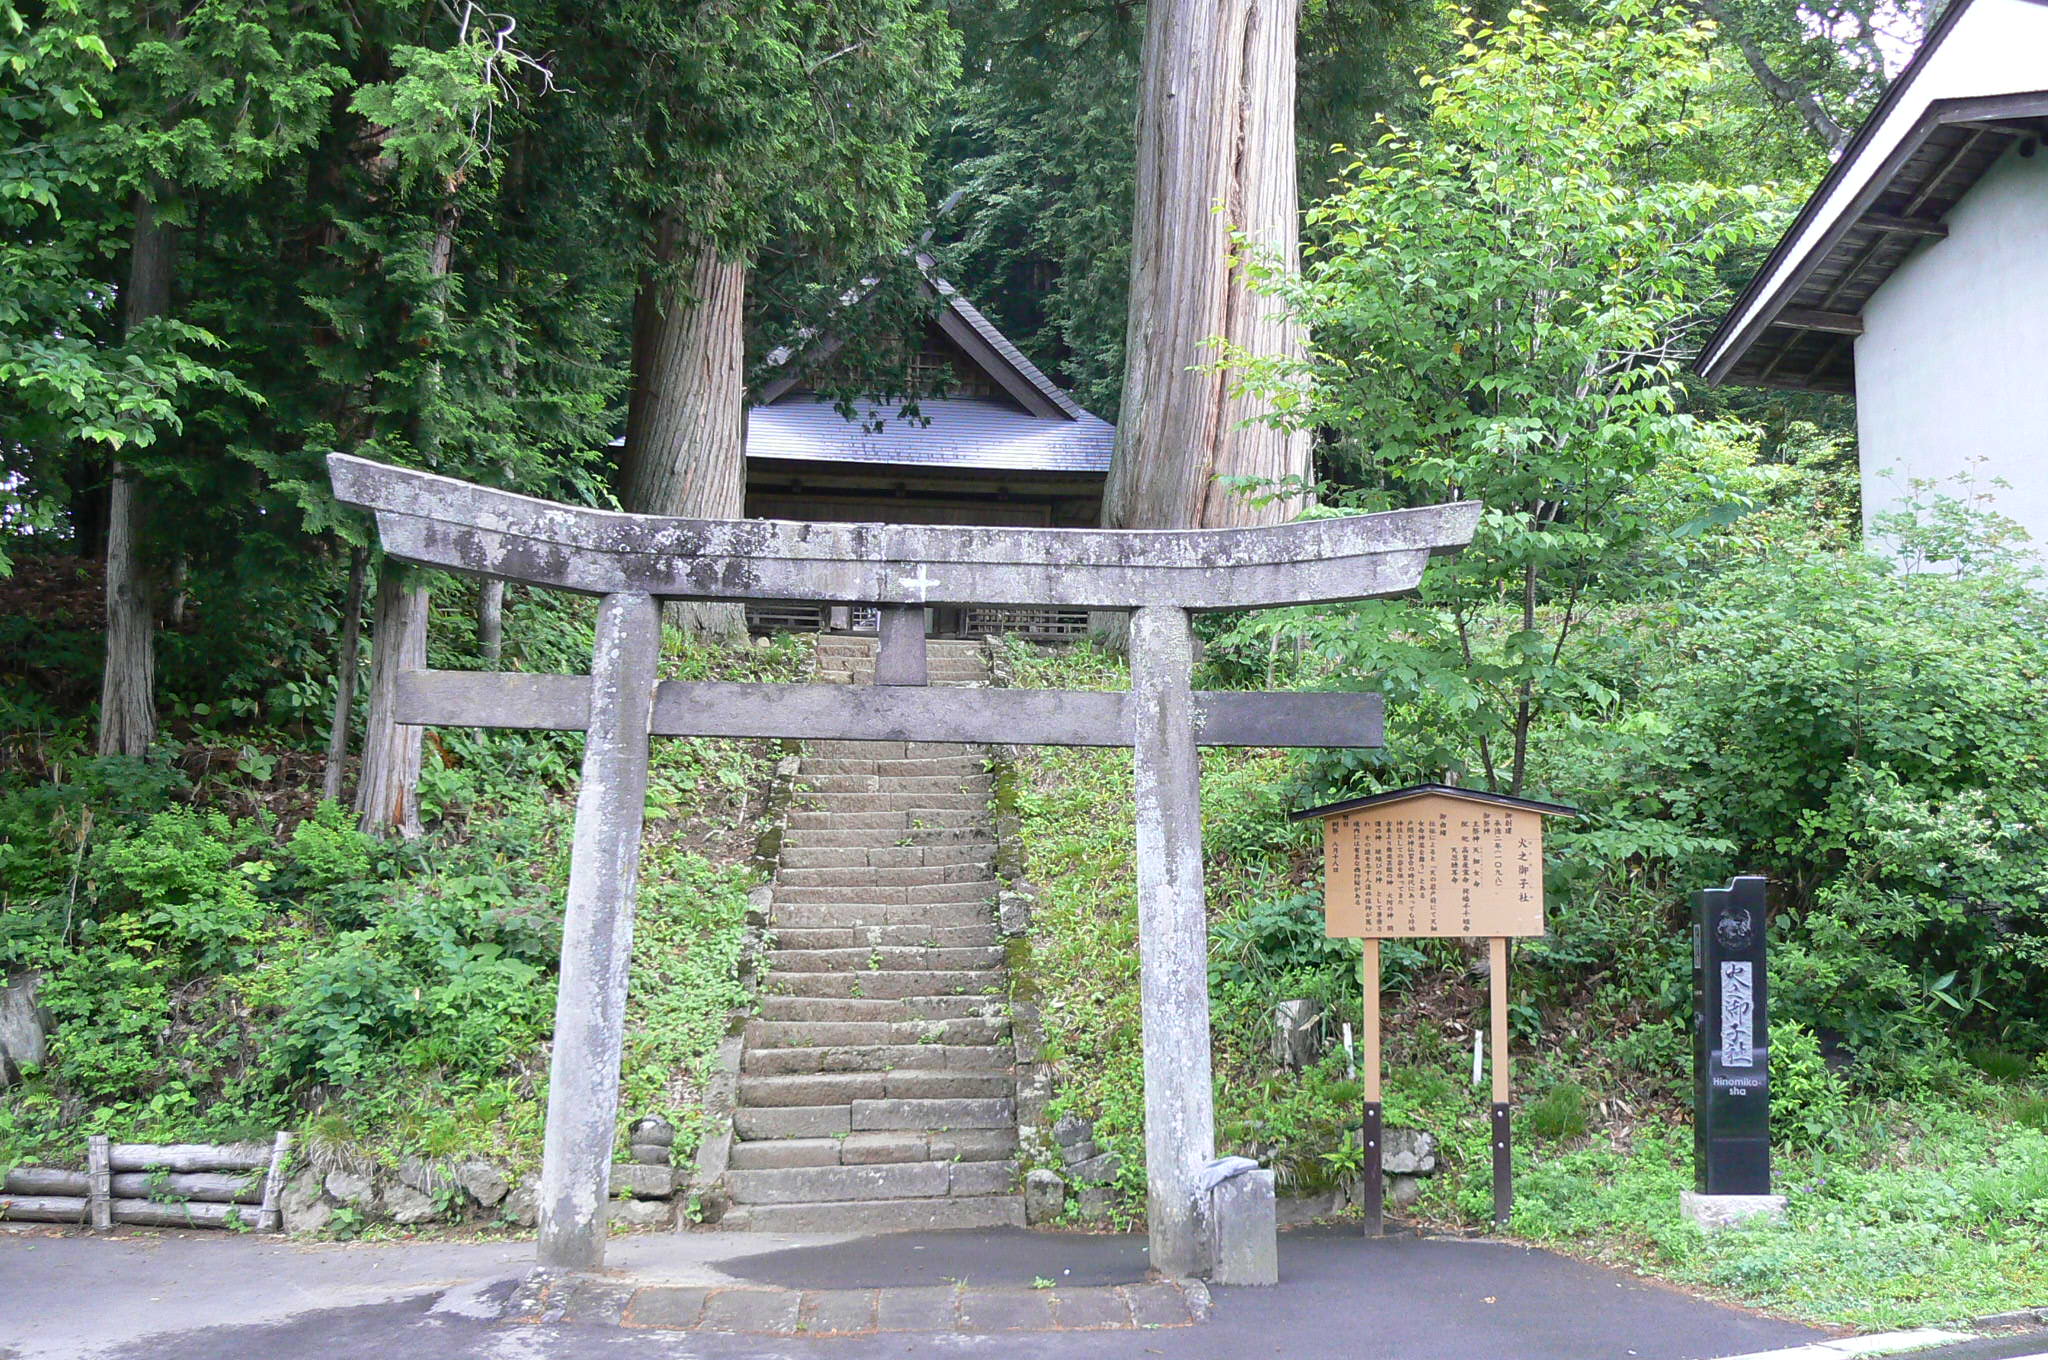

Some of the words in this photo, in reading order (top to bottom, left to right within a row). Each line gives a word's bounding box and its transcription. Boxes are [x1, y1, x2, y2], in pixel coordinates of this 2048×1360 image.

[1518, 837, 1529, 903] 火之御子社
[1725, 963, 1752, 1065] 火之御子社
[1713, 1076, 1761, 1087] Hinomiko-
[1729, 1086, 1746, 1096] sha
